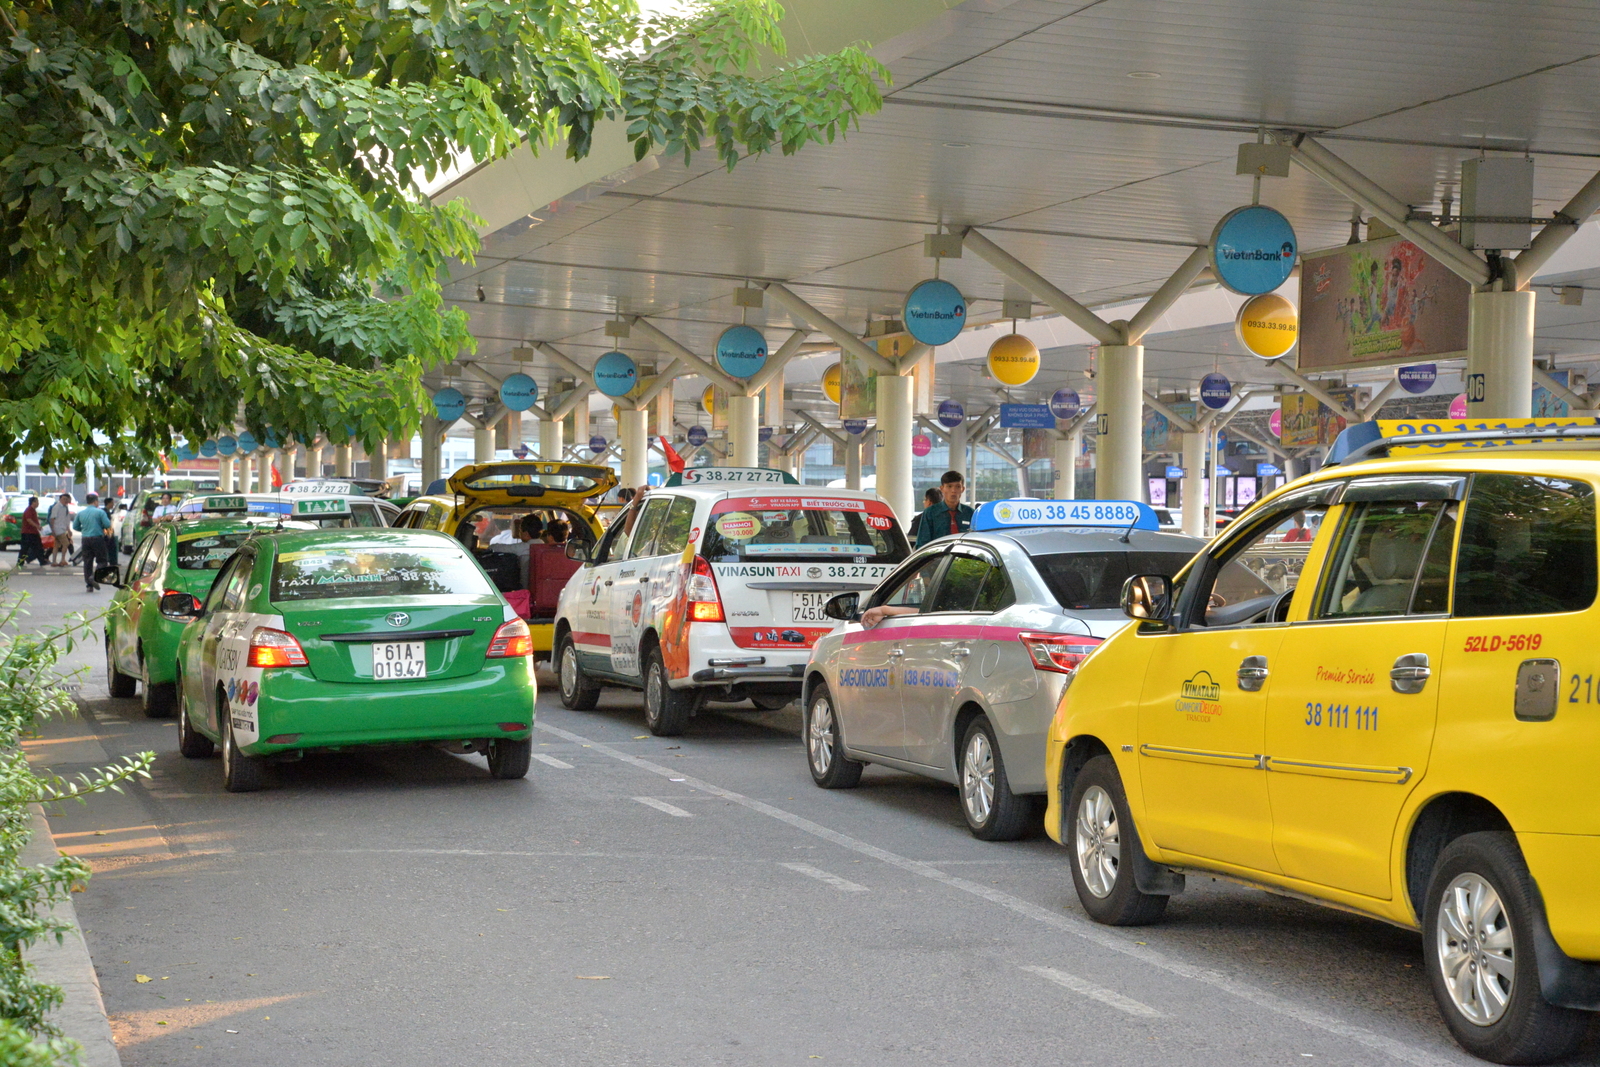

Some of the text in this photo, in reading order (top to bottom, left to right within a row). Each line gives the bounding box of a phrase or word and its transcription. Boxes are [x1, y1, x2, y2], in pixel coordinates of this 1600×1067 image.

[1222, 248, 1281, 261] VietinBank
[910, 310, 954, 320] VietinBank
[1247, 320, 1297, 331] 0933.33.99.88
[720, 350, 757, 359] VietinBank
[706, 470, 781, 482] 38.27 27 27
[214, 499, 239, 507] TAXI
[1018, 505, 1135, 521] (08) 38 45 8888
[868, 516, 890, 528] 7061
[178, 554, 205, 562] TAXI
[828, 566, 866, 577] 38.27
[870, 567, 886, 578] 27
[280, 578, 315, 588] TAXI
[402, 571, 419, 581] 38
[802, 593, 823, 607] 51A
[794, 607, 830, 622] 745.0
[1463, 633, 1543, 653] 52LD-5619
[385, 644, 414, 661] 61A
[374, 660, 424, 679] 019.47
[1315, 665, 1376, 685] Premier Service
[839, 668, 889, 687] SAIGONTOURIST
[919, 671, 930, 687] 45
[932, 671, 944, 688] 88
[1185, 683, 1218, 698] VINATAXI
[1305, 702, 1378, 731] 38 111 111
